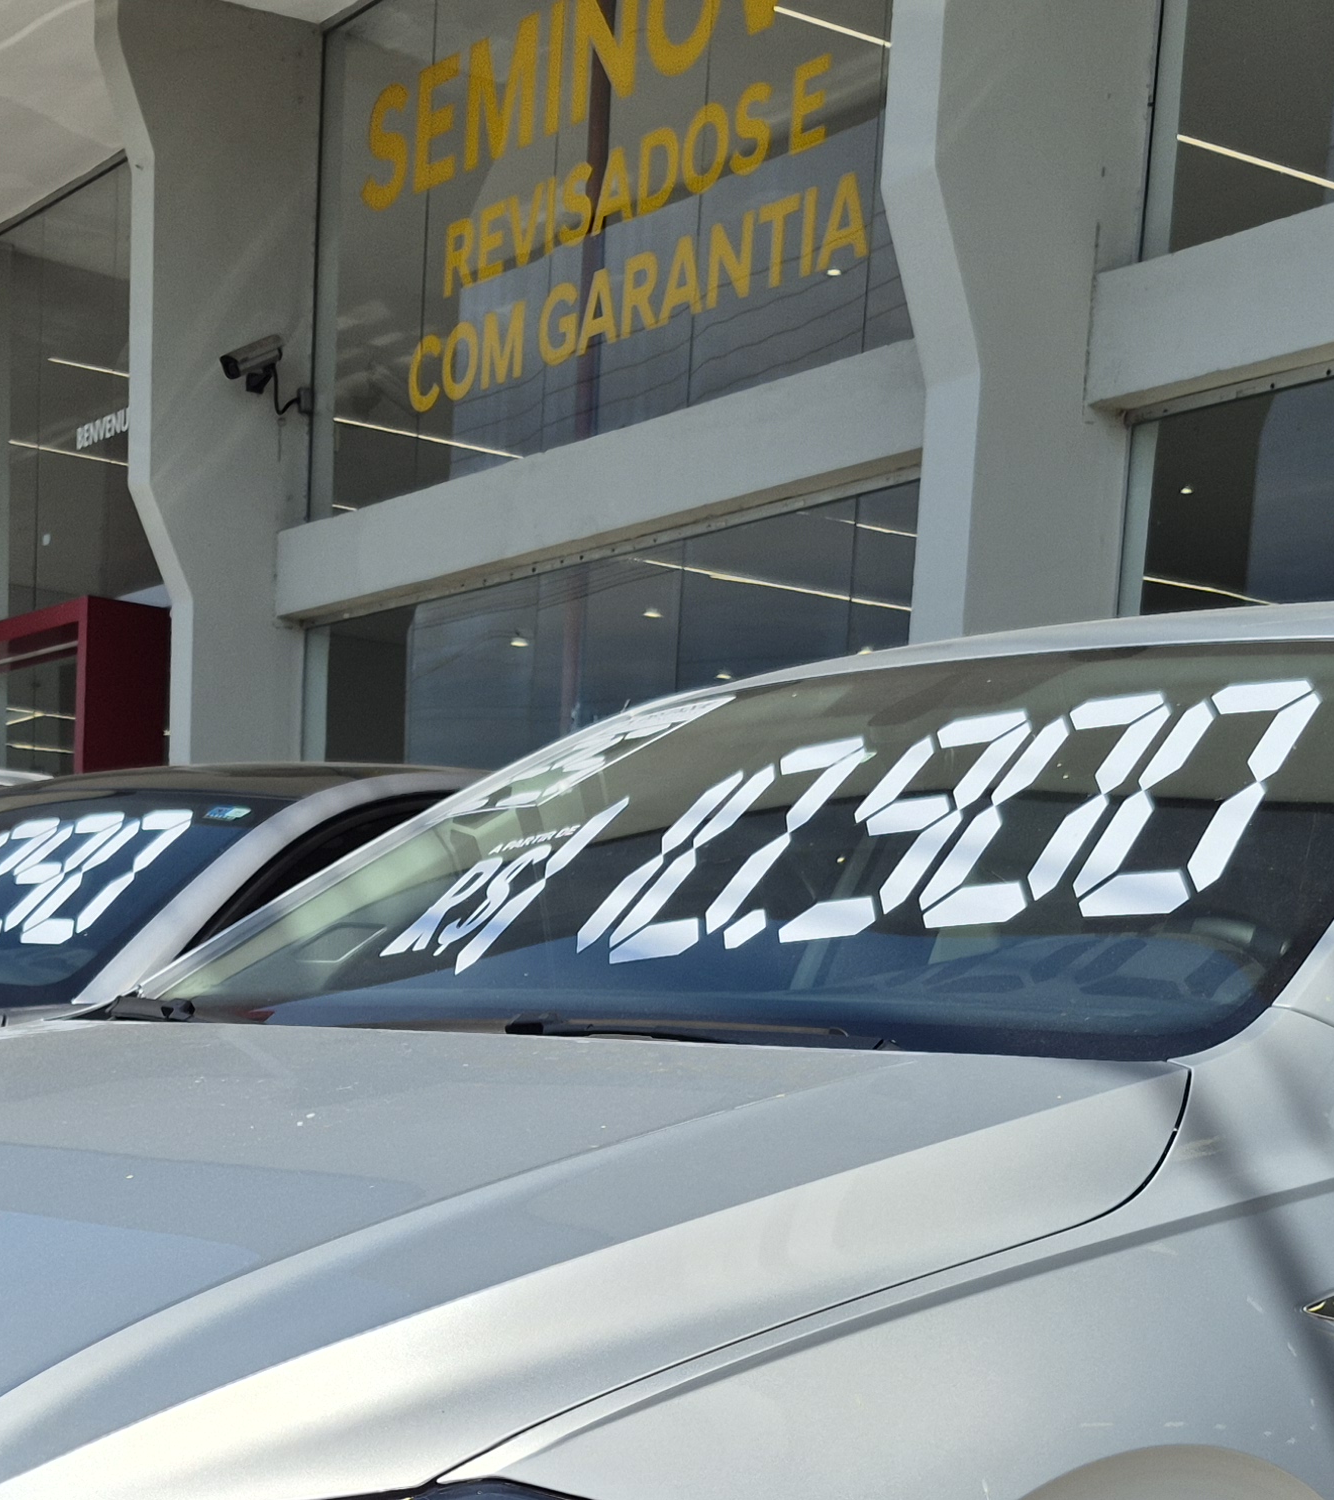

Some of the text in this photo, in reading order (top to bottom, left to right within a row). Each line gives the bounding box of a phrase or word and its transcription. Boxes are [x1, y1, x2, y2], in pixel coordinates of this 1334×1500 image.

[360, 0, 777, 211] SEMINO
[443, 53, 833, 298] REVISADOS E
[407, 172, 868, 412] COM GARANTIA
[379, 843, 553, 958] R$
[501, 829, 557, 853] PARTIR
[555, 824, 581, 839] DE
